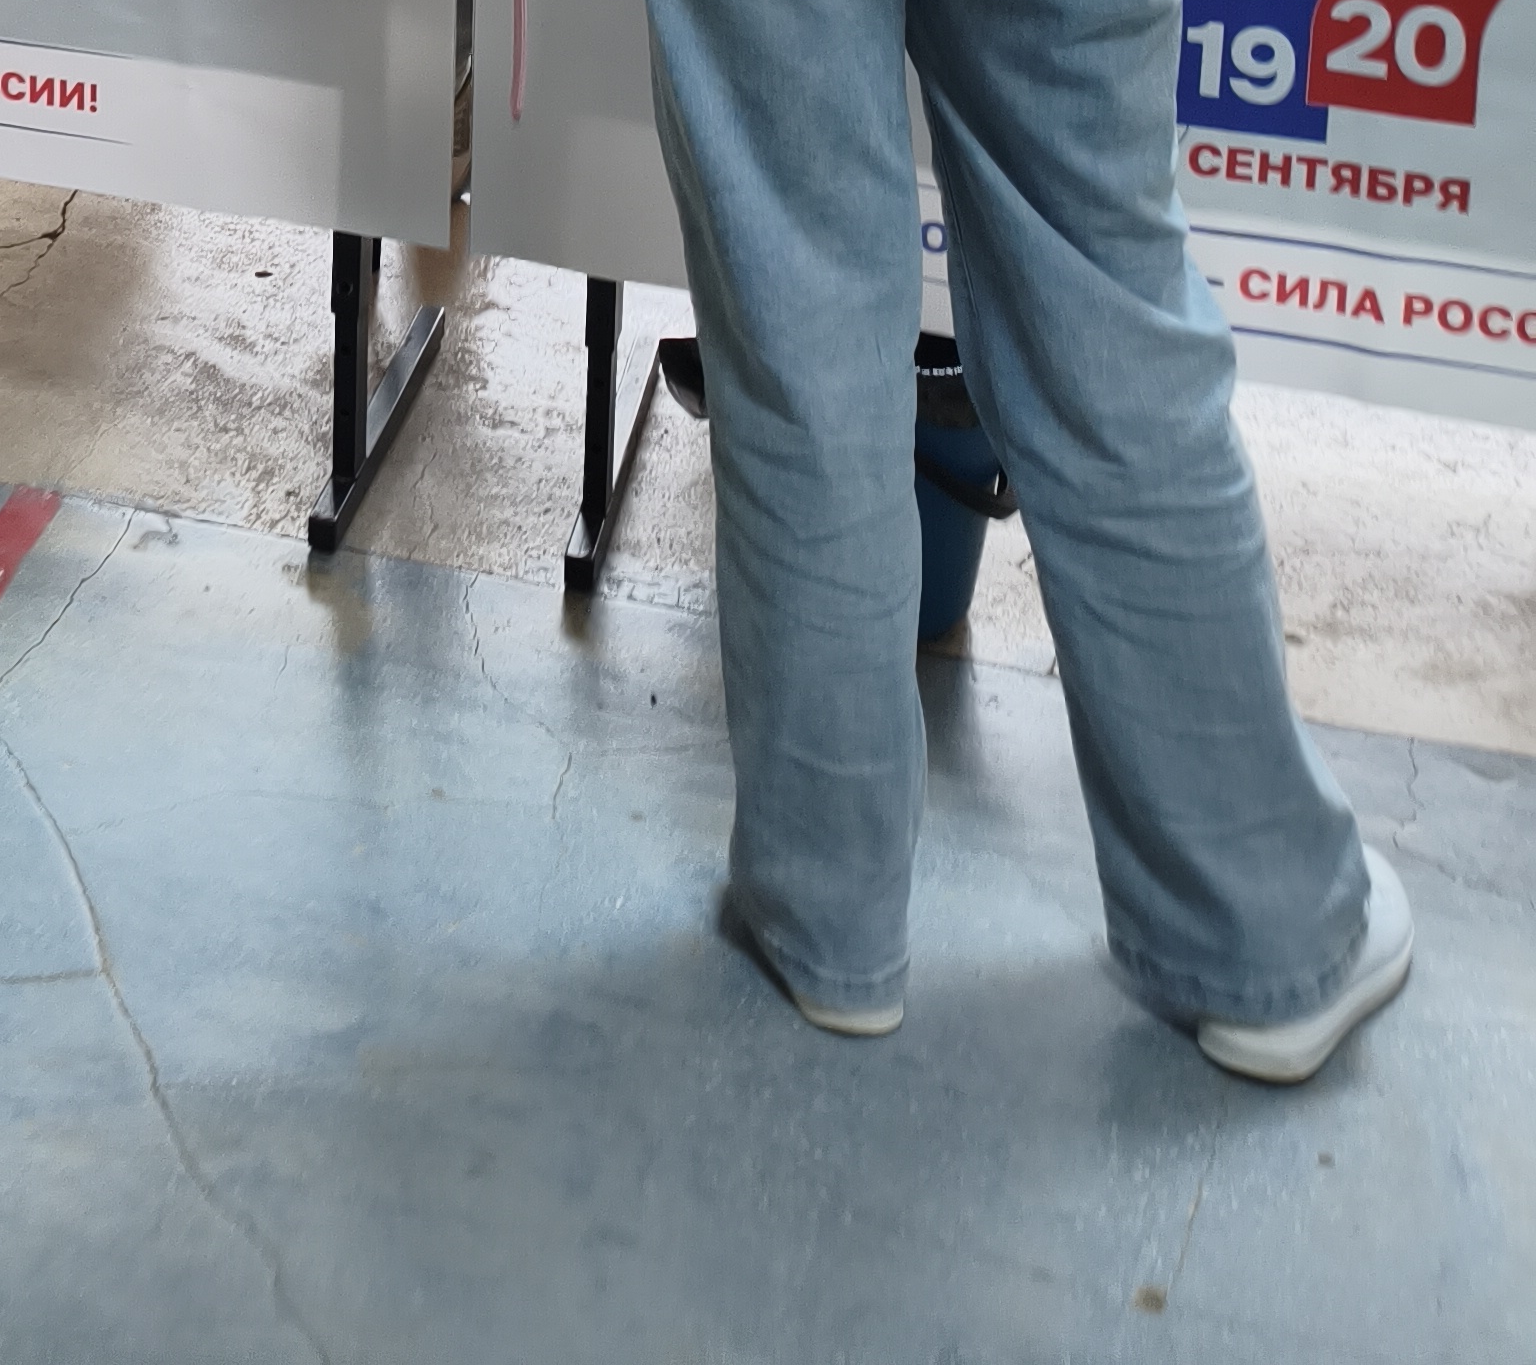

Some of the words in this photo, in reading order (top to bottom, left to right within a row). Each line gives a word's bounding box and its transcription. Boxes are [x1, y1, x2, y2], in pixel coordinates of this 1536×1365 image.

[1186, 21, 1296, 106] 19
[1188, 144, 1472, 215] СЕНТЯБРЯ
[1239, 267, 1385, 324] СИЛА
